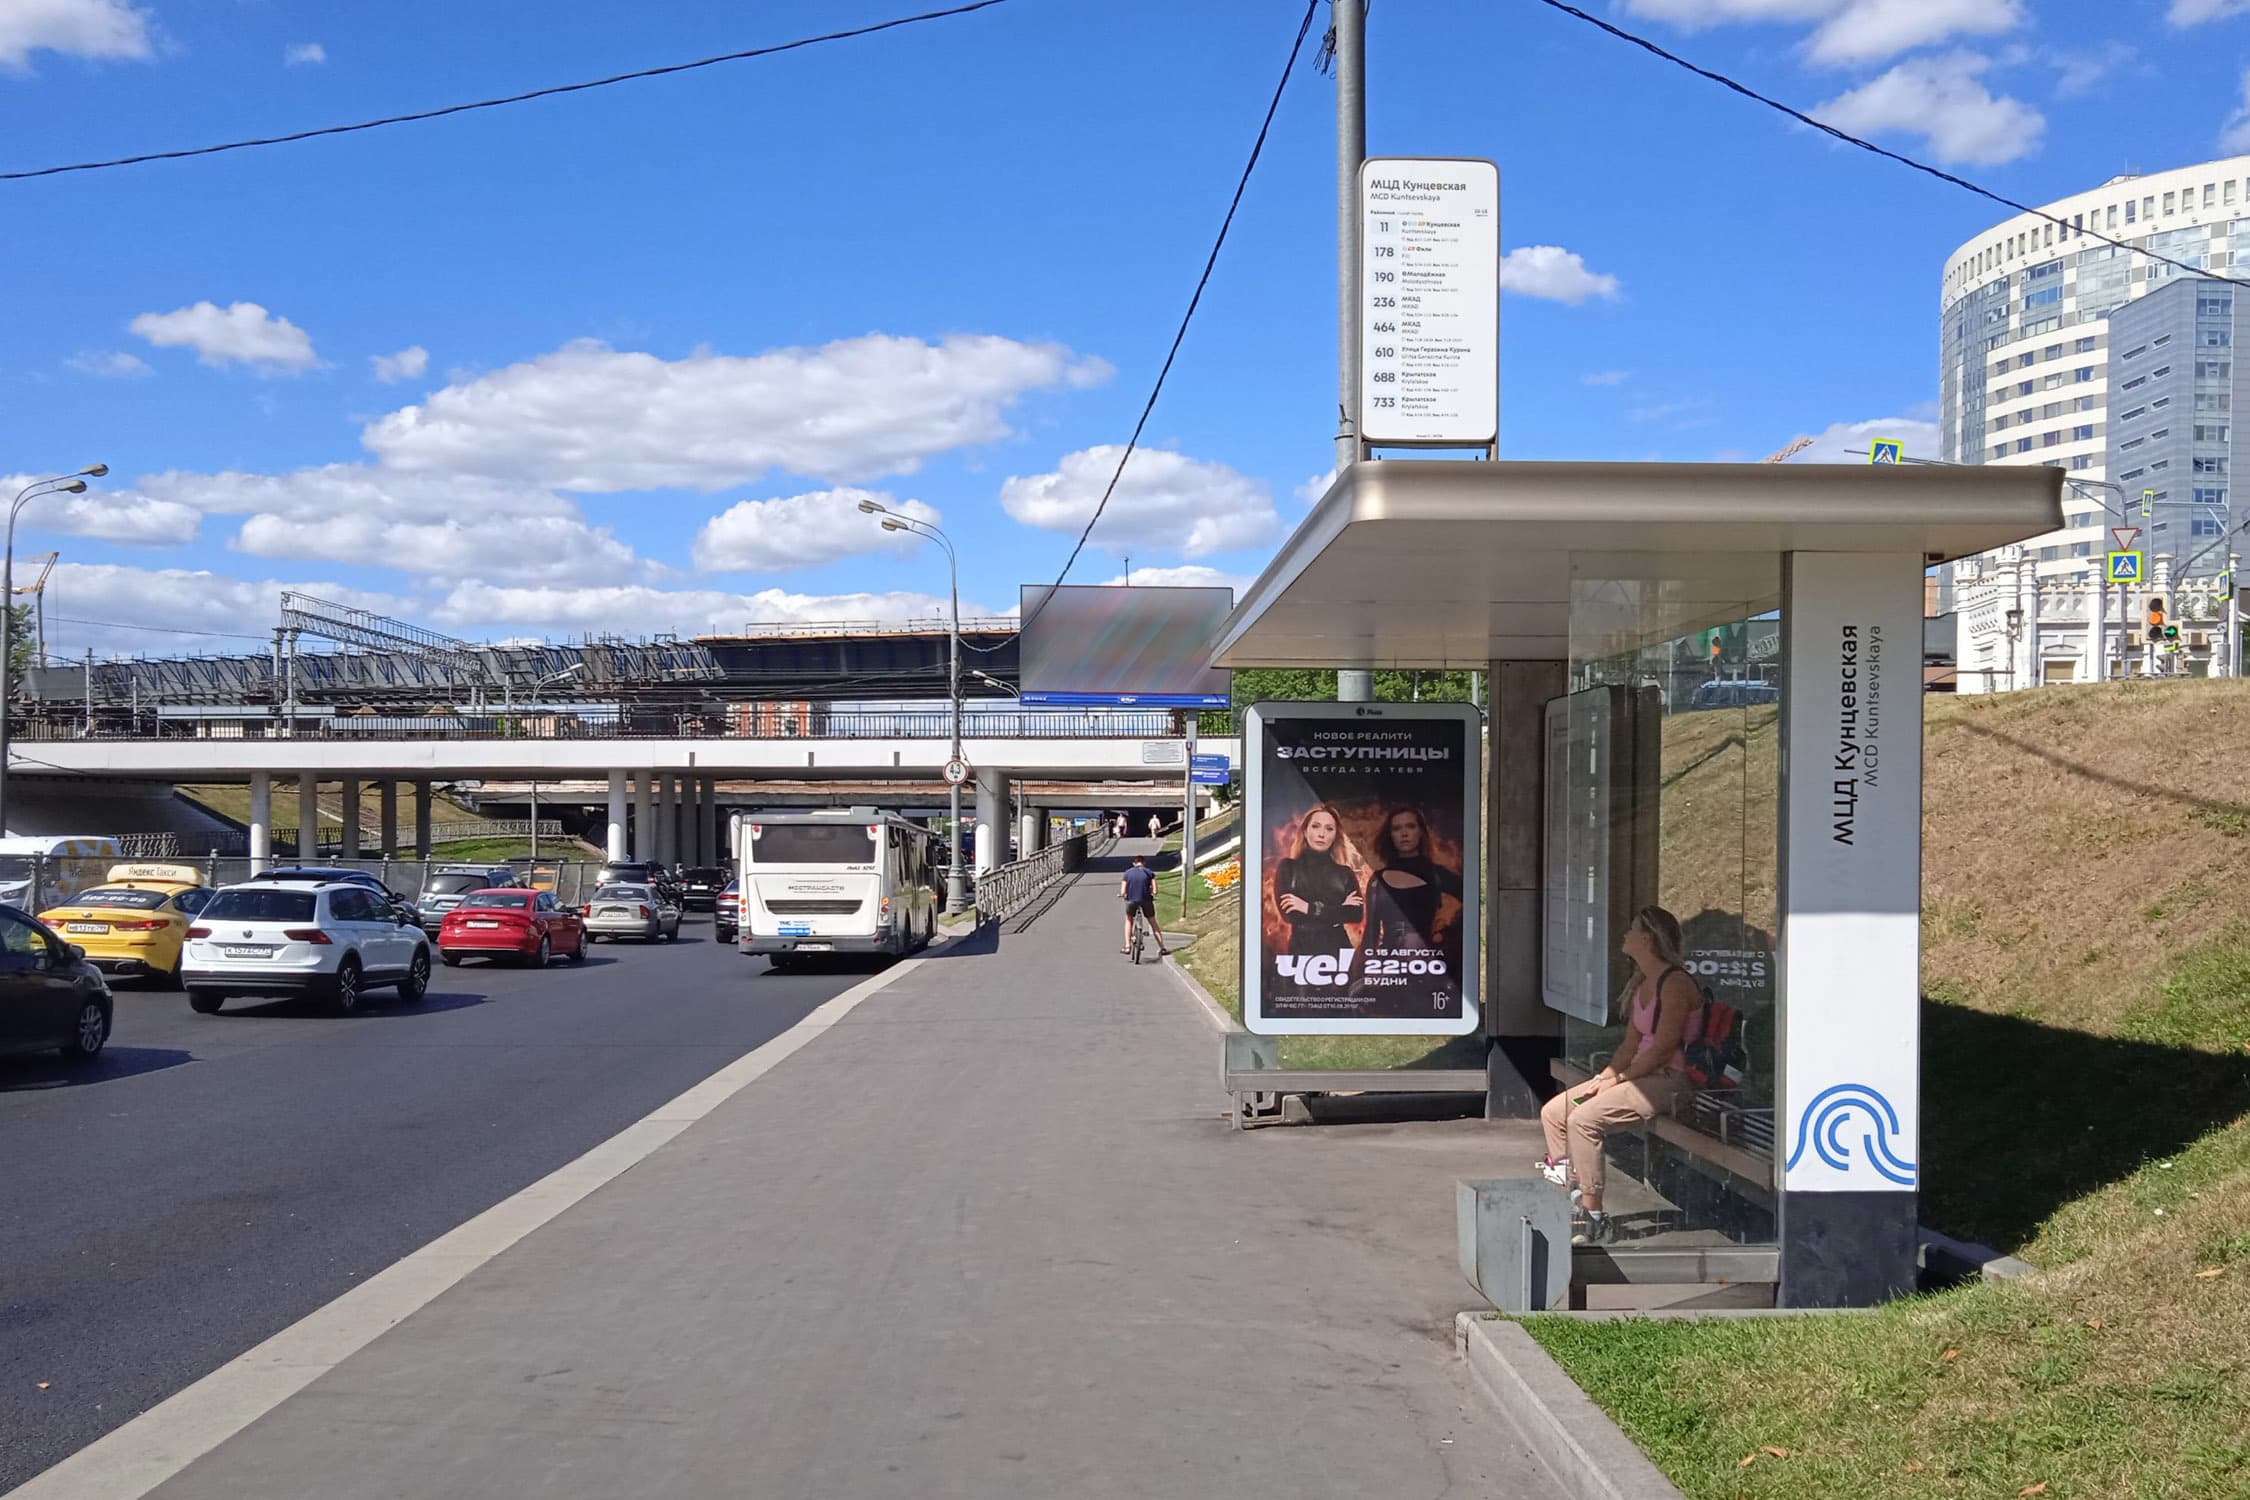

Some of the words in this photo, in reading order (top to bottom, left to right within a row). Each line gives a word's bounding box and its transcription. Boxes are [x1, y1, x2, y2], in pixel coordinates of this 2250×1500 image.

[1371, 180, 1400, 191] МЦД
[1403, 180, 1466, 192] Кунцевская
[1371, 193, 1389, 201] MCD
[1391, 193, 1441, 202] Kuntsevskaya
[1380, 222, 1389, 232] 11
[1375, 247, 1394, 257] 178
[1375, 272, 1394, 282] 190
[1374, 297, 1395, 307] 236
[1374, 322, 1395, 332] 464
[1375, 347, 1394, 358] 610
[1374, 372, 1395, 382] 688
[1374, 397, 1395, 407] 733
[1864, 625, 1884, 739] Kuntsevskaya
[1834, 625, 1861, 771] Кунцевская
[1314, 731, 1354, 740] НОВОЕ
[1357, 732, 1412, 741] РЕАЛИТИ
[1276, 746, 1449, 761] ЗАСТУПНИЦЫ
[1303, 766, 1357, 774] ВСЕГДА
[1864, 743, 1880, 788] MCD
[1833, 778, 1859, 846] МЦД
[128, 866, 155, 876] Яндекс
[156, 867, 177, 877] Такси
[1364, 949, 1373, 957] С
[1376, 949, 1388, 957] 15
[1391, 949, 1445, 957] АВГУСТА
[1364, 959, 1447, 975] 22:00
[1364, 977, 1408, 986] БУДНИ
[1431, 991, 1451, 1010] 16+
